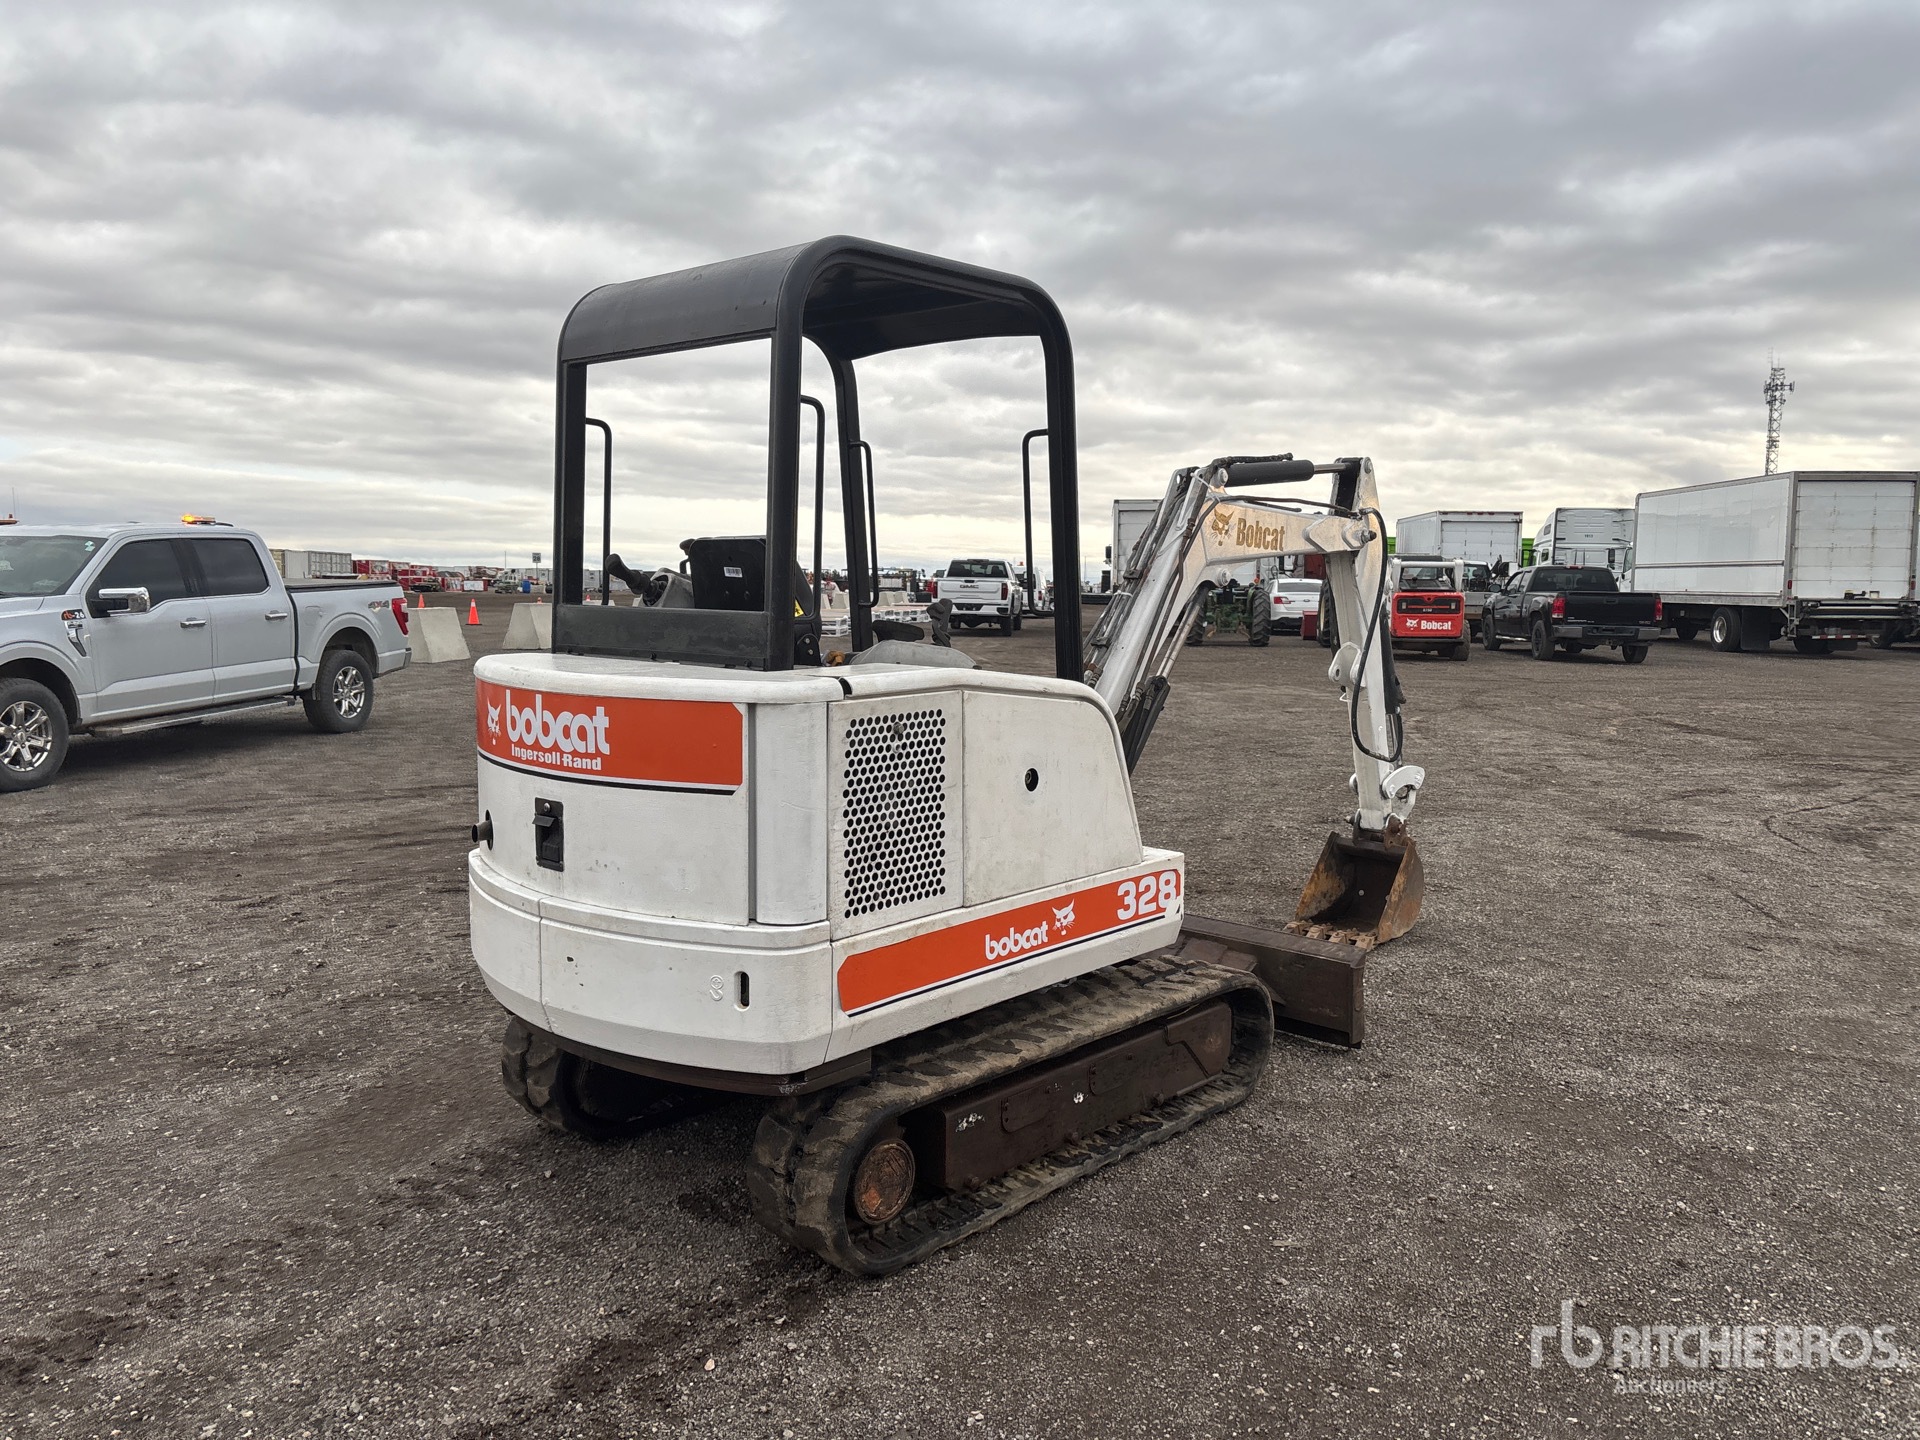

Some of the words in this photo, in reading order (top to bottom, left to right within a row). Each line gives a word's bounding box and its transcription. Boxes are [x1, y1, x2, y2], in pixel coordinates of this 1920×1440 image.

[1236, 517, 1286, 552] Bobcat
[1421, 619, 1452, 631] Bobcat
[505, 689, 611, 755] bobcat
[1116, 870, 1177, 920] 328
[984, 920, 1049, 961] bobcat
